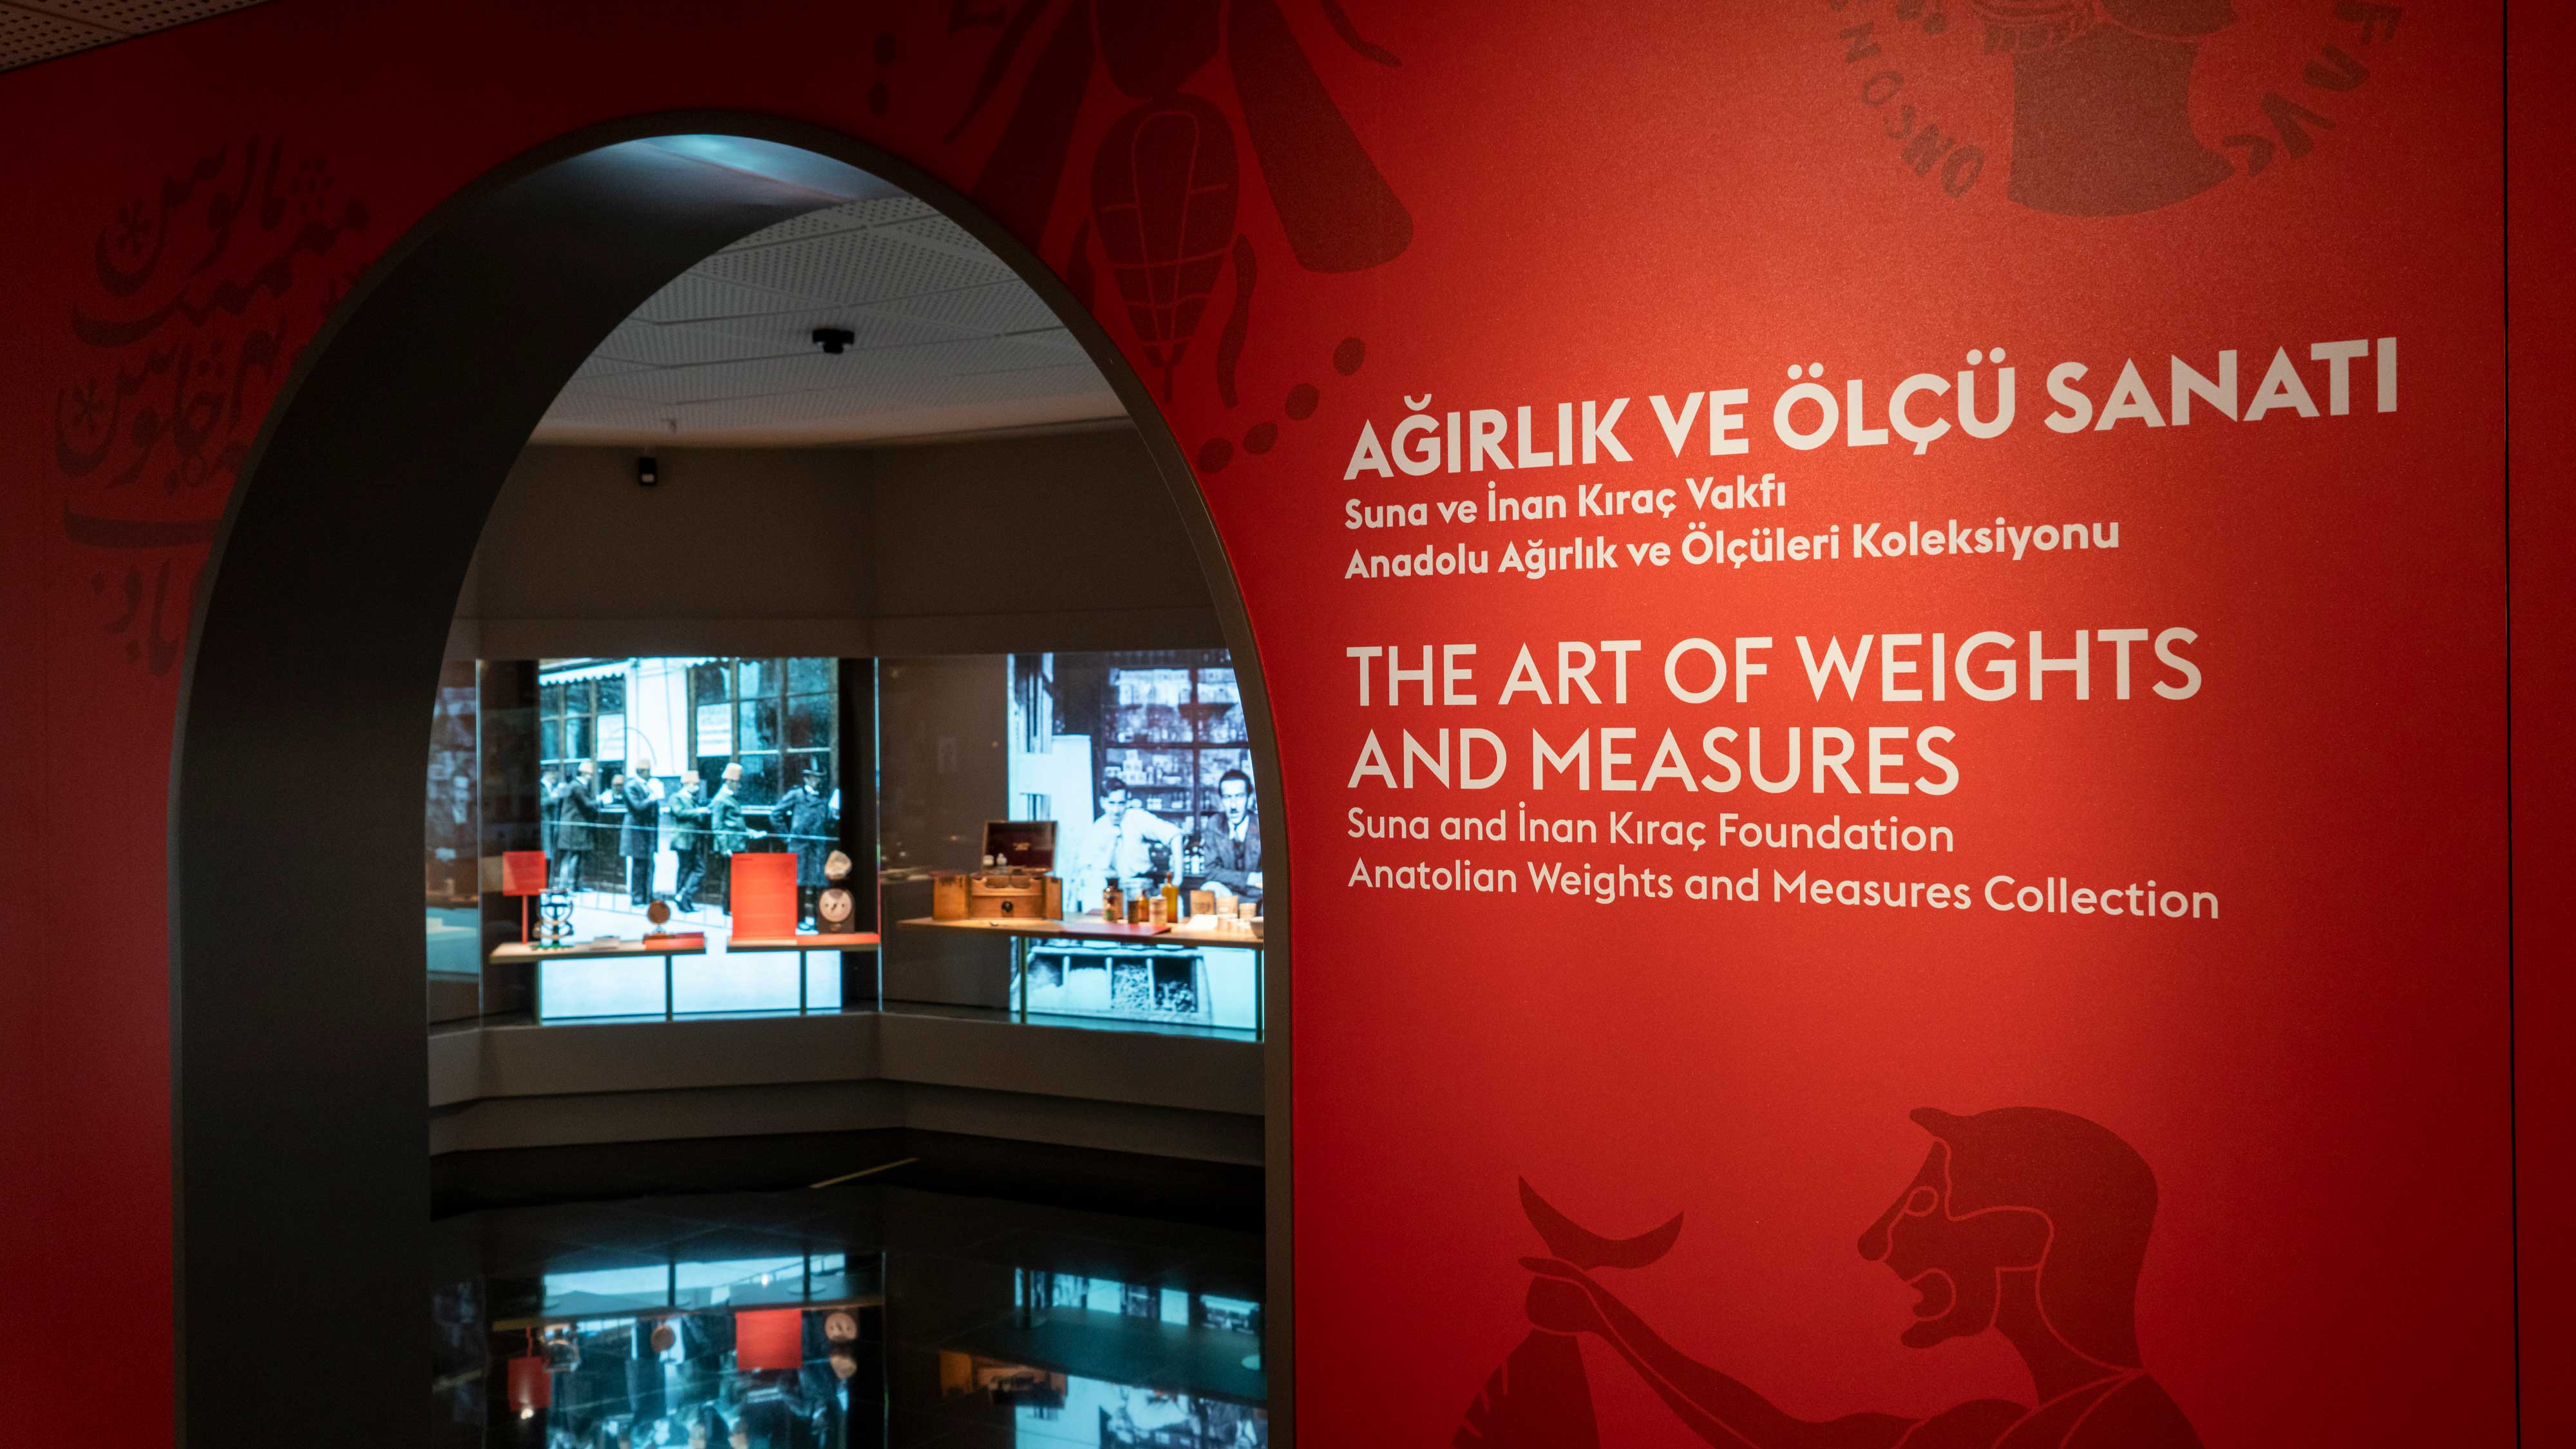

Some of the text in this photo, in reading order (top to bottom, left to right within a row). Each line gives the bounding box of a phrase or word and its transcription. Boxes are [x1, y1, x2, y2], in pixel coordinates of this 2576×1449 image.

[1343, 337, 2397, 480] AĞIRLIK VE ÖLÇÜ SANATI
[1345, 473, 1786, 529] Suna ve İnan Kıraç Vakfı
[1344, 516, 2119, 580] Anadolu Ağırlık ve Ölçüleri Koleksiyonu
[1346, 627, 2202, 706] THE ART OF WEIGHTS
[1347, 725, 1960, 796] AND MEASURES
[1347, 800, 1953, 852] Suna and İnan Kıraç Foundation
[1348, 857, 2219, 919] Anatolian Weights and Measures Collection
